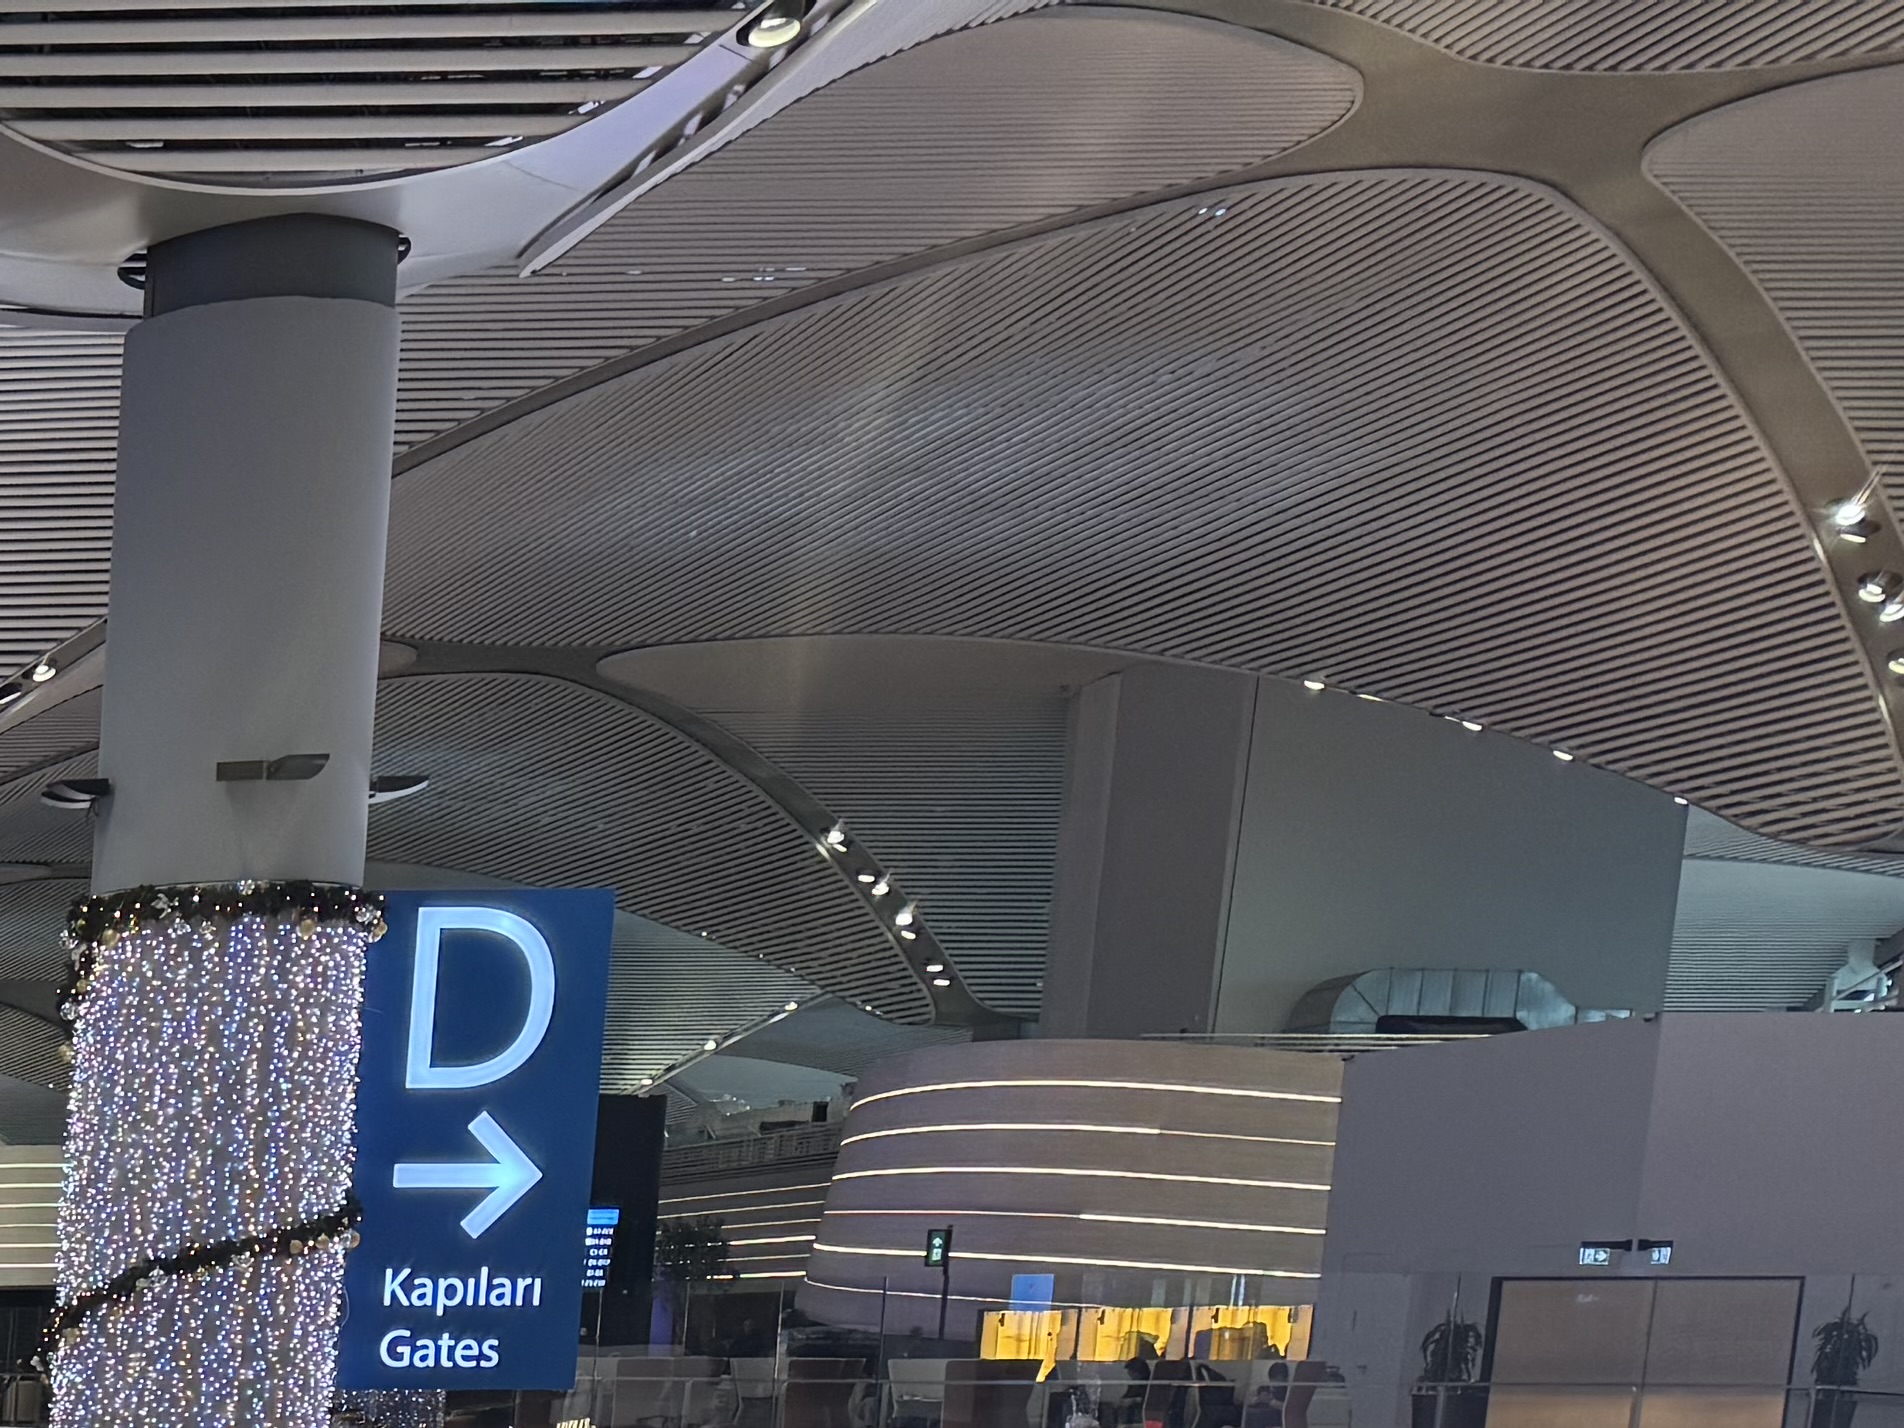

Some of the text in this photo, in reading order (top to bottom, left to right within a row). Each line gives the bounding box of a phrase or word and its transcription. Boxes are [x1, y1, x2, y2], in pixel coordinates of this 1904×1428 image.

[405, 906, 556, 1089] D
[382, 1266, 542, 1316] Kapıları
[379, 1329, 500, 1368] Gates
